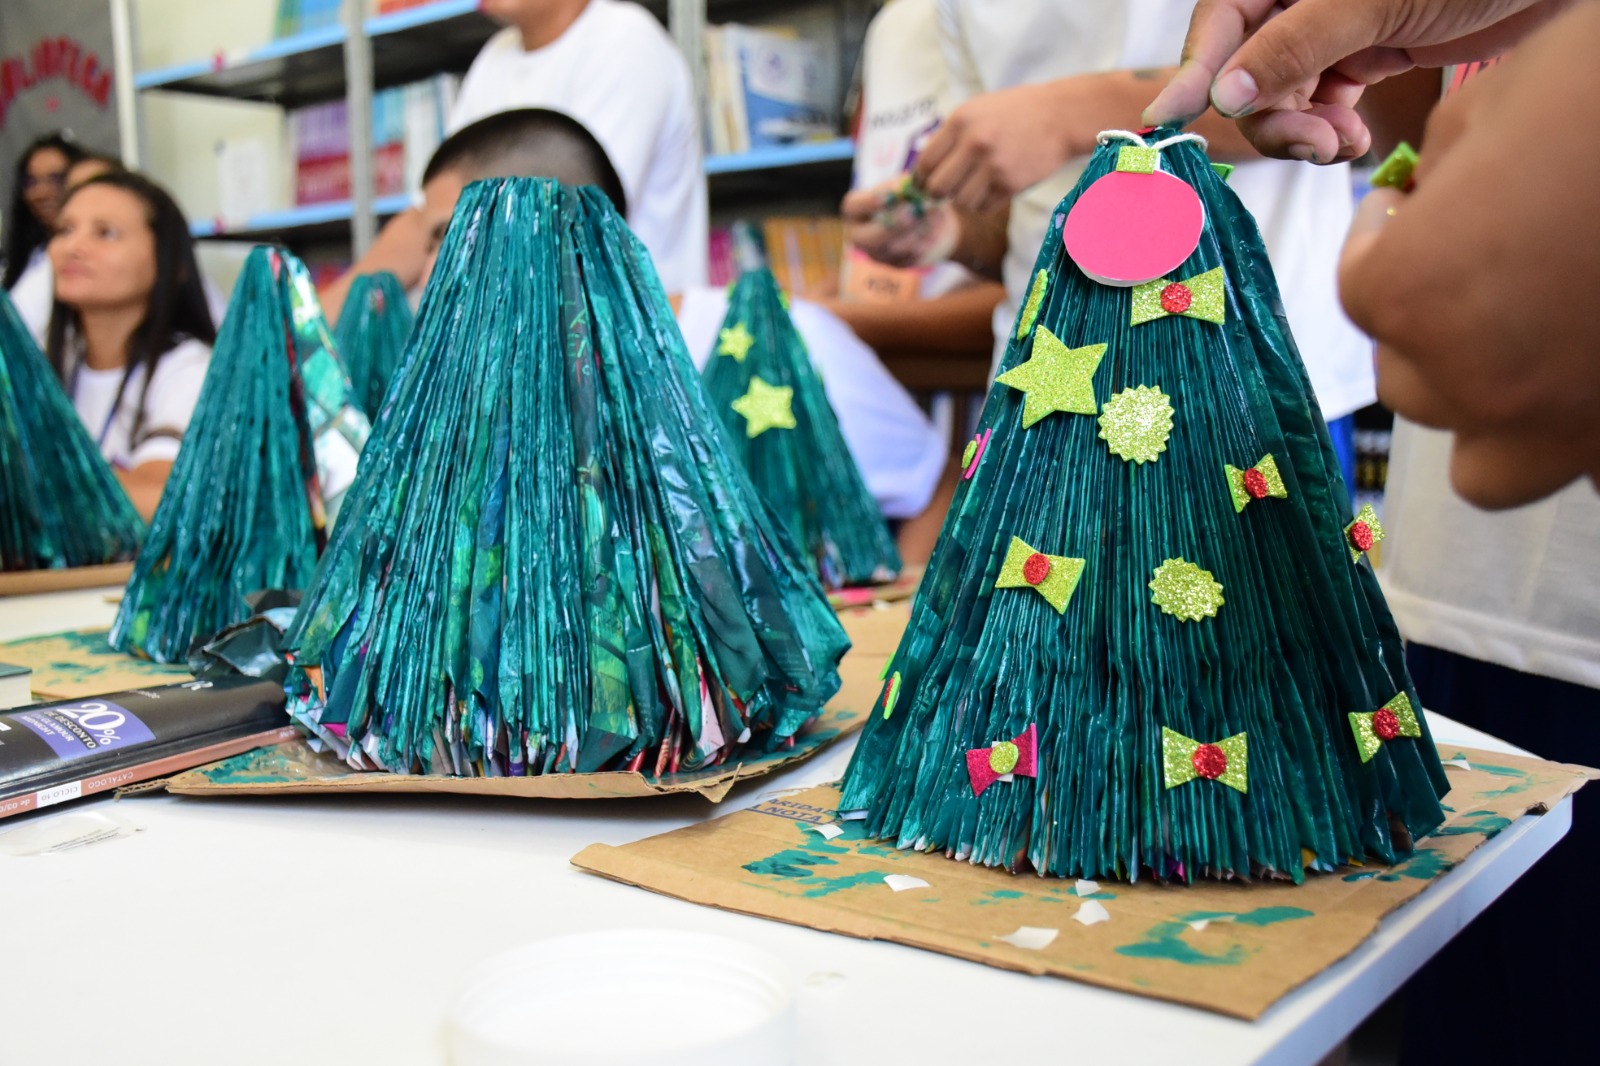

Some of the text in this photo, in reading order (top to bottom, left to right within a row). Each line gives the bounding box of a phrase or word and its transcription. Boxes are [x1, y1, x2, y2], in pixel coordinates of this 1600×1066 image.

[41, 716, 74, 743] GLAMOUR
[54, 713, 97, 749] DESCONTO
[56, 702, 125, 745] 20%
[88, 771, 134, 789] CATÁLOGO
[53, 786, 78, 798] CICLO
[765, 807, 825, 823] NOTA
